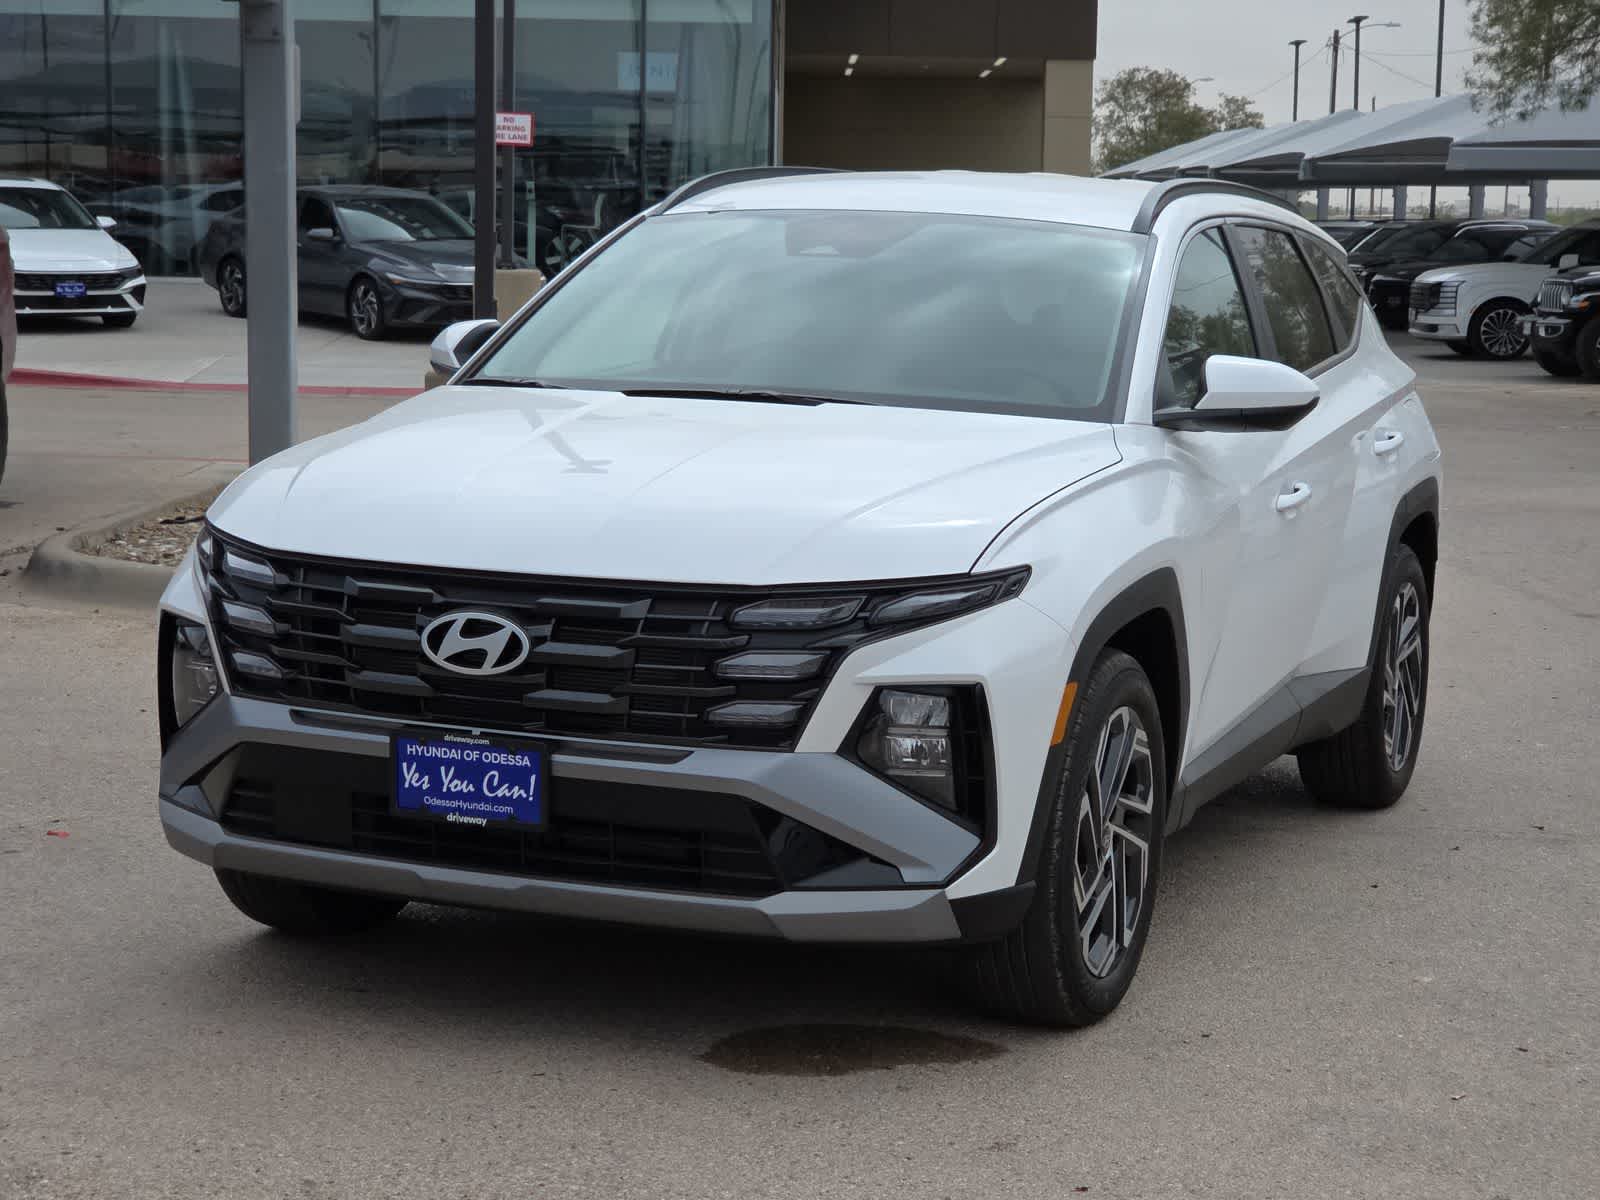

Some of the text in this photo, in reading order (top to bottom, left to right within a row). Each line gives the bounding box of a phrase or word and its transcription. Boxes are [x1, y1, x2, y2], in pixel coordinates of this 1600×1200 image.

[496, 124, 526, 132] ARKING
[508, 133, 527, 141] LANE
[444, 734, 490, 745] driveway.com
[407, 744, 531, 767] HYUNDAI OF ODESSA
[402, 762, 537, 801] Yes You Can!
[423, 796, 514, 814] OdessaHyundai.com
[446, 812, 488, 827] driveway
